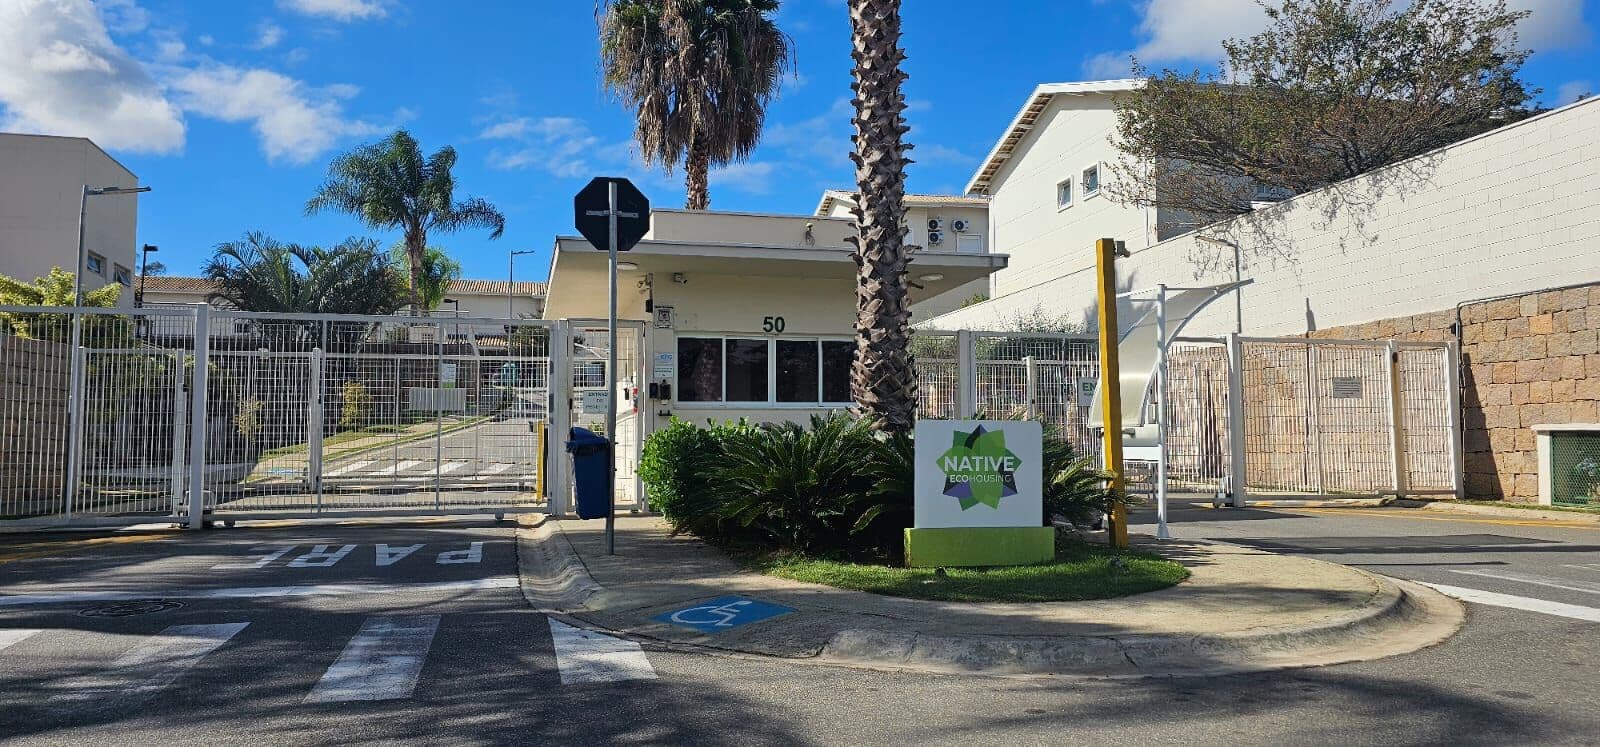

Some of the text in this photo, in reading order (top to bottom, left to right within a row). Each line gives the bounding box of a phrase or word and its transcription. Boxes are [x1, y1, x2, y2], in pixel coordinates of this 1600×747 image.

[763, 316, 786, 333] 50
[944, 456, 1015, 472] NATIVE
[950, 474, 1012, 483] ECOHOUSING
[210, 542, 484, 570] PARE
